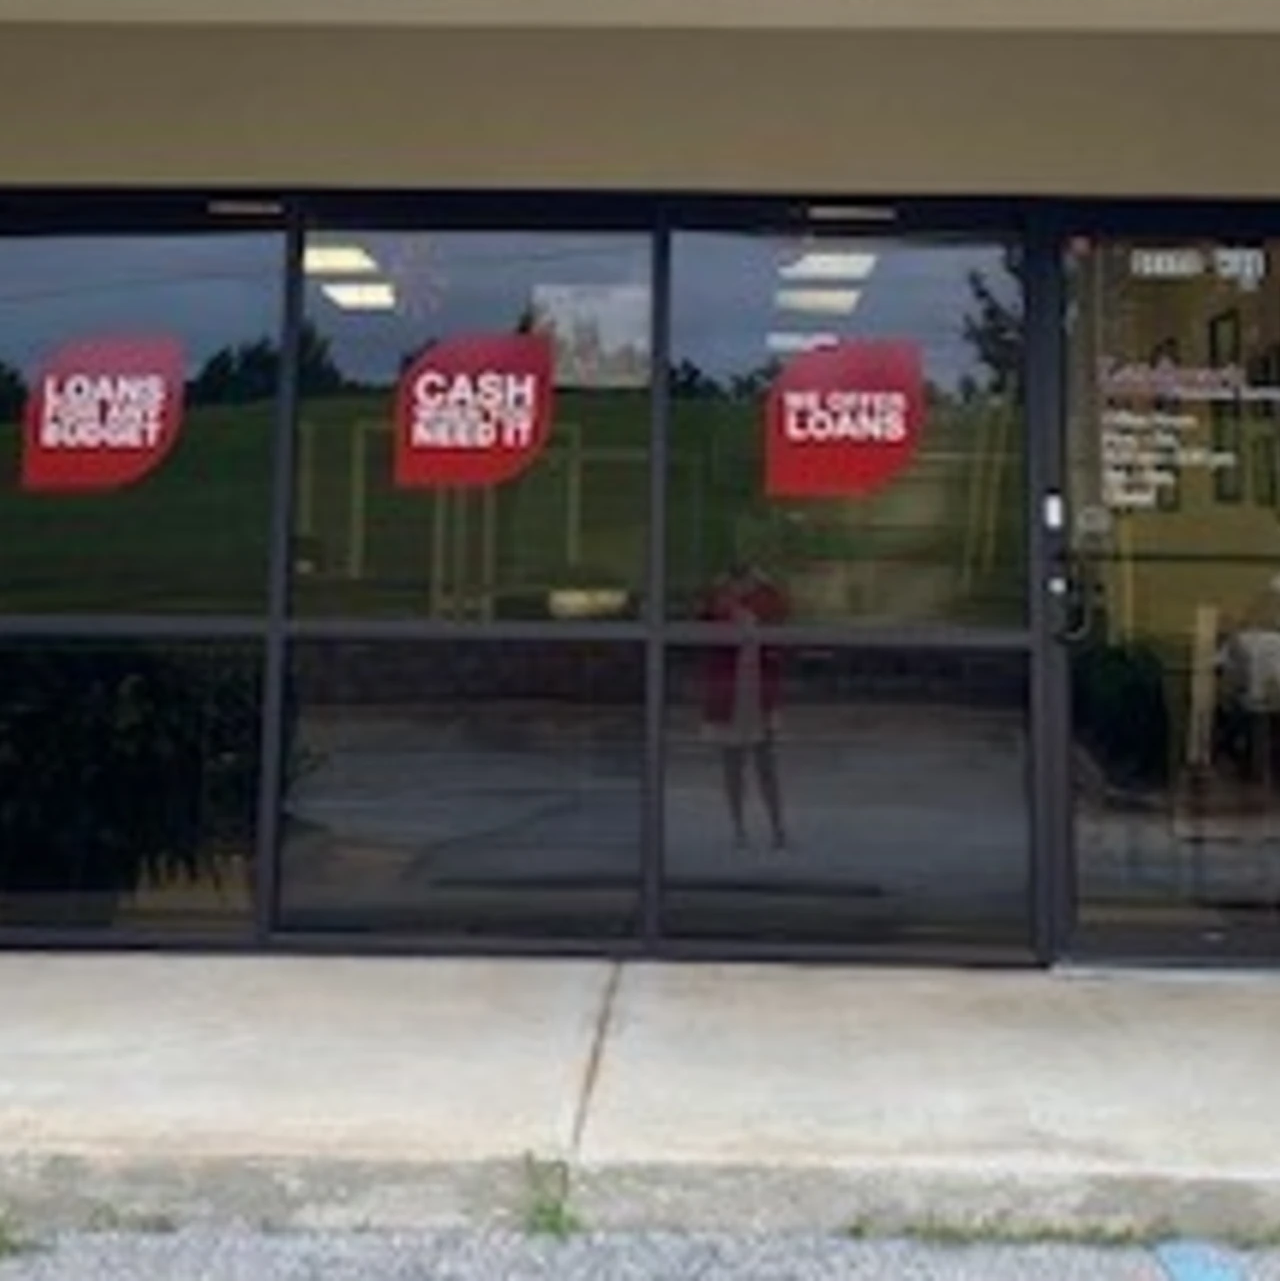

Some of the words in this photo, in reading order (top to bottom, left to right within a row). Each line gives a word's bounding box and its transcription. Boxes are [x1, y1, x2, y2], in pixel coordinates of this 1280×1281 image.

[45, 374, 166, 404] LOANS
[414, 371, 536, 409] CASH
[786, 411, 907, 441] LOANS
